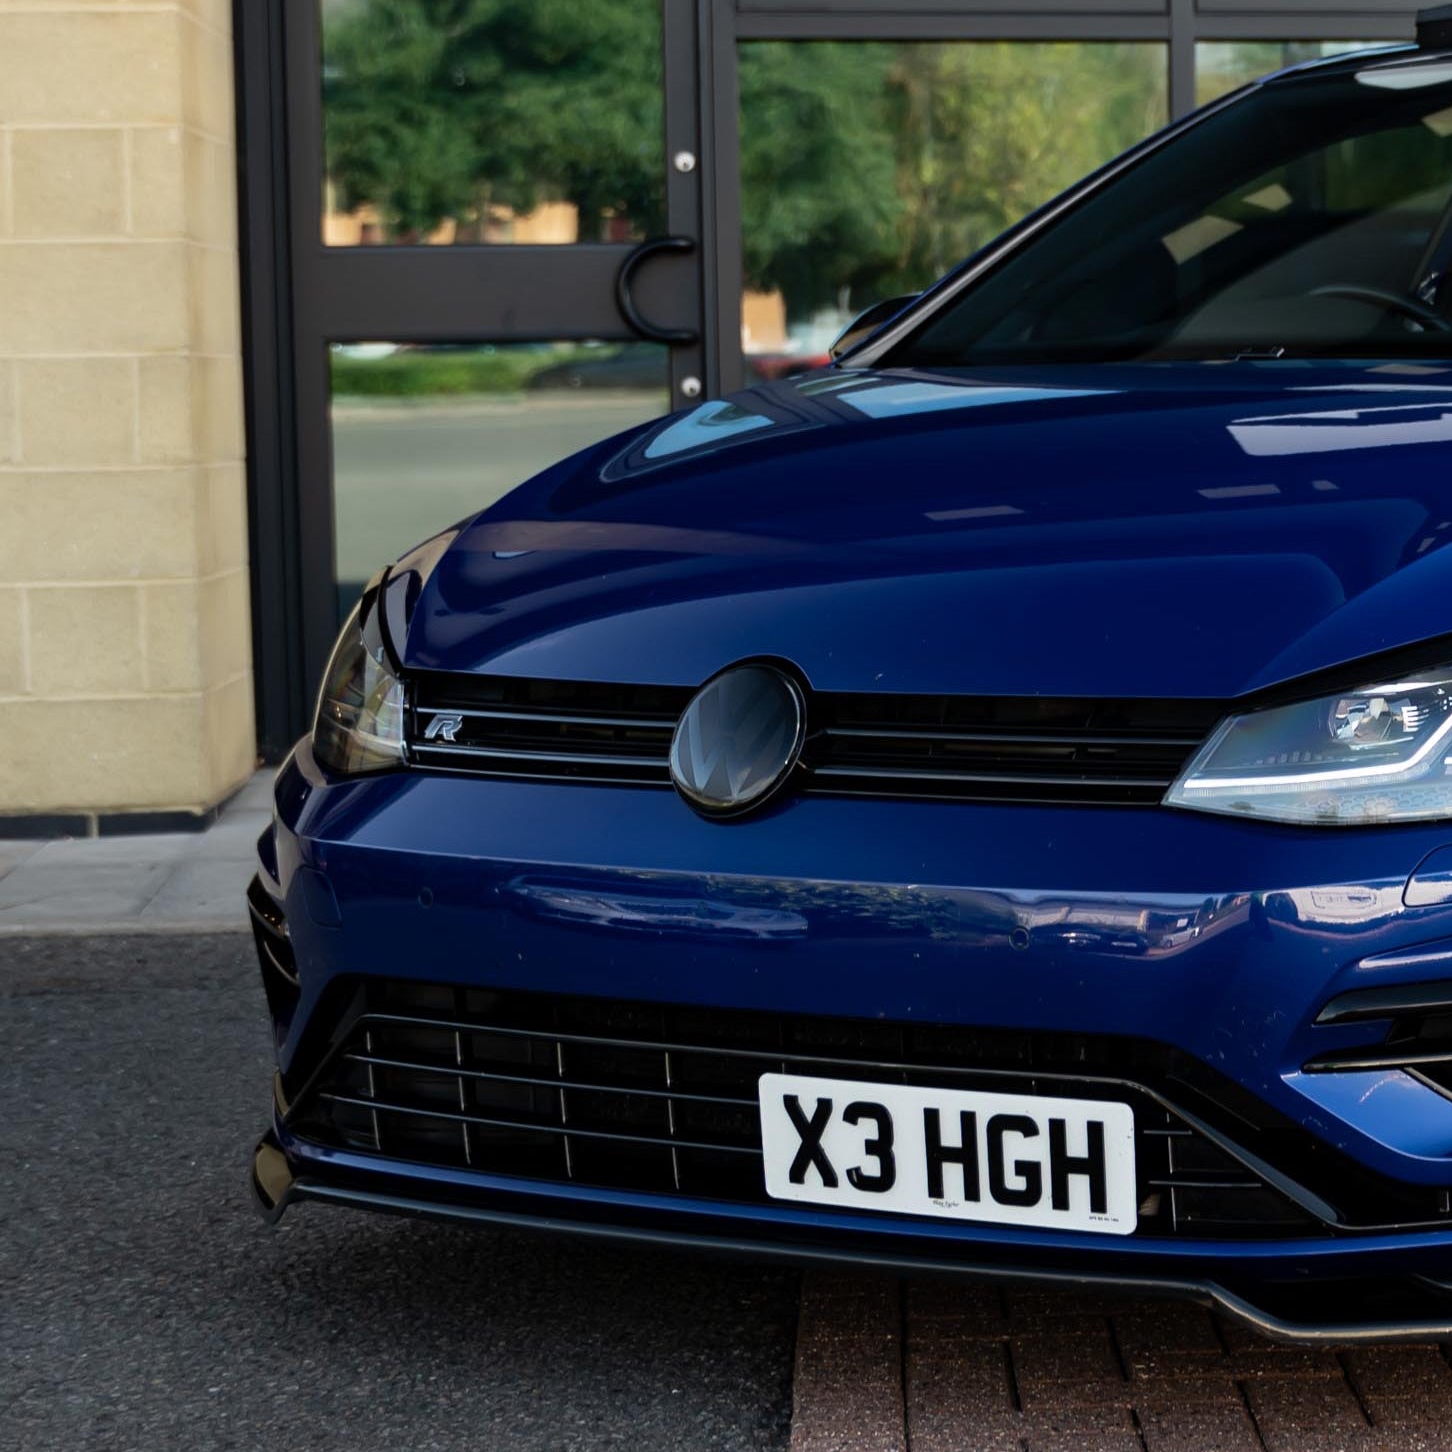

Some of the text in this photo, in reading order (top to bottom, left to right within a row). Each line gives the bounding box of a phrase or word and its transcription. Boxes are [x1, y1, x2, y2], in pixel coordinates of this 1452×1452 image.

[424, 714, 463, 742] R
[782, 1094, 1107, 1214] X3 HGH
